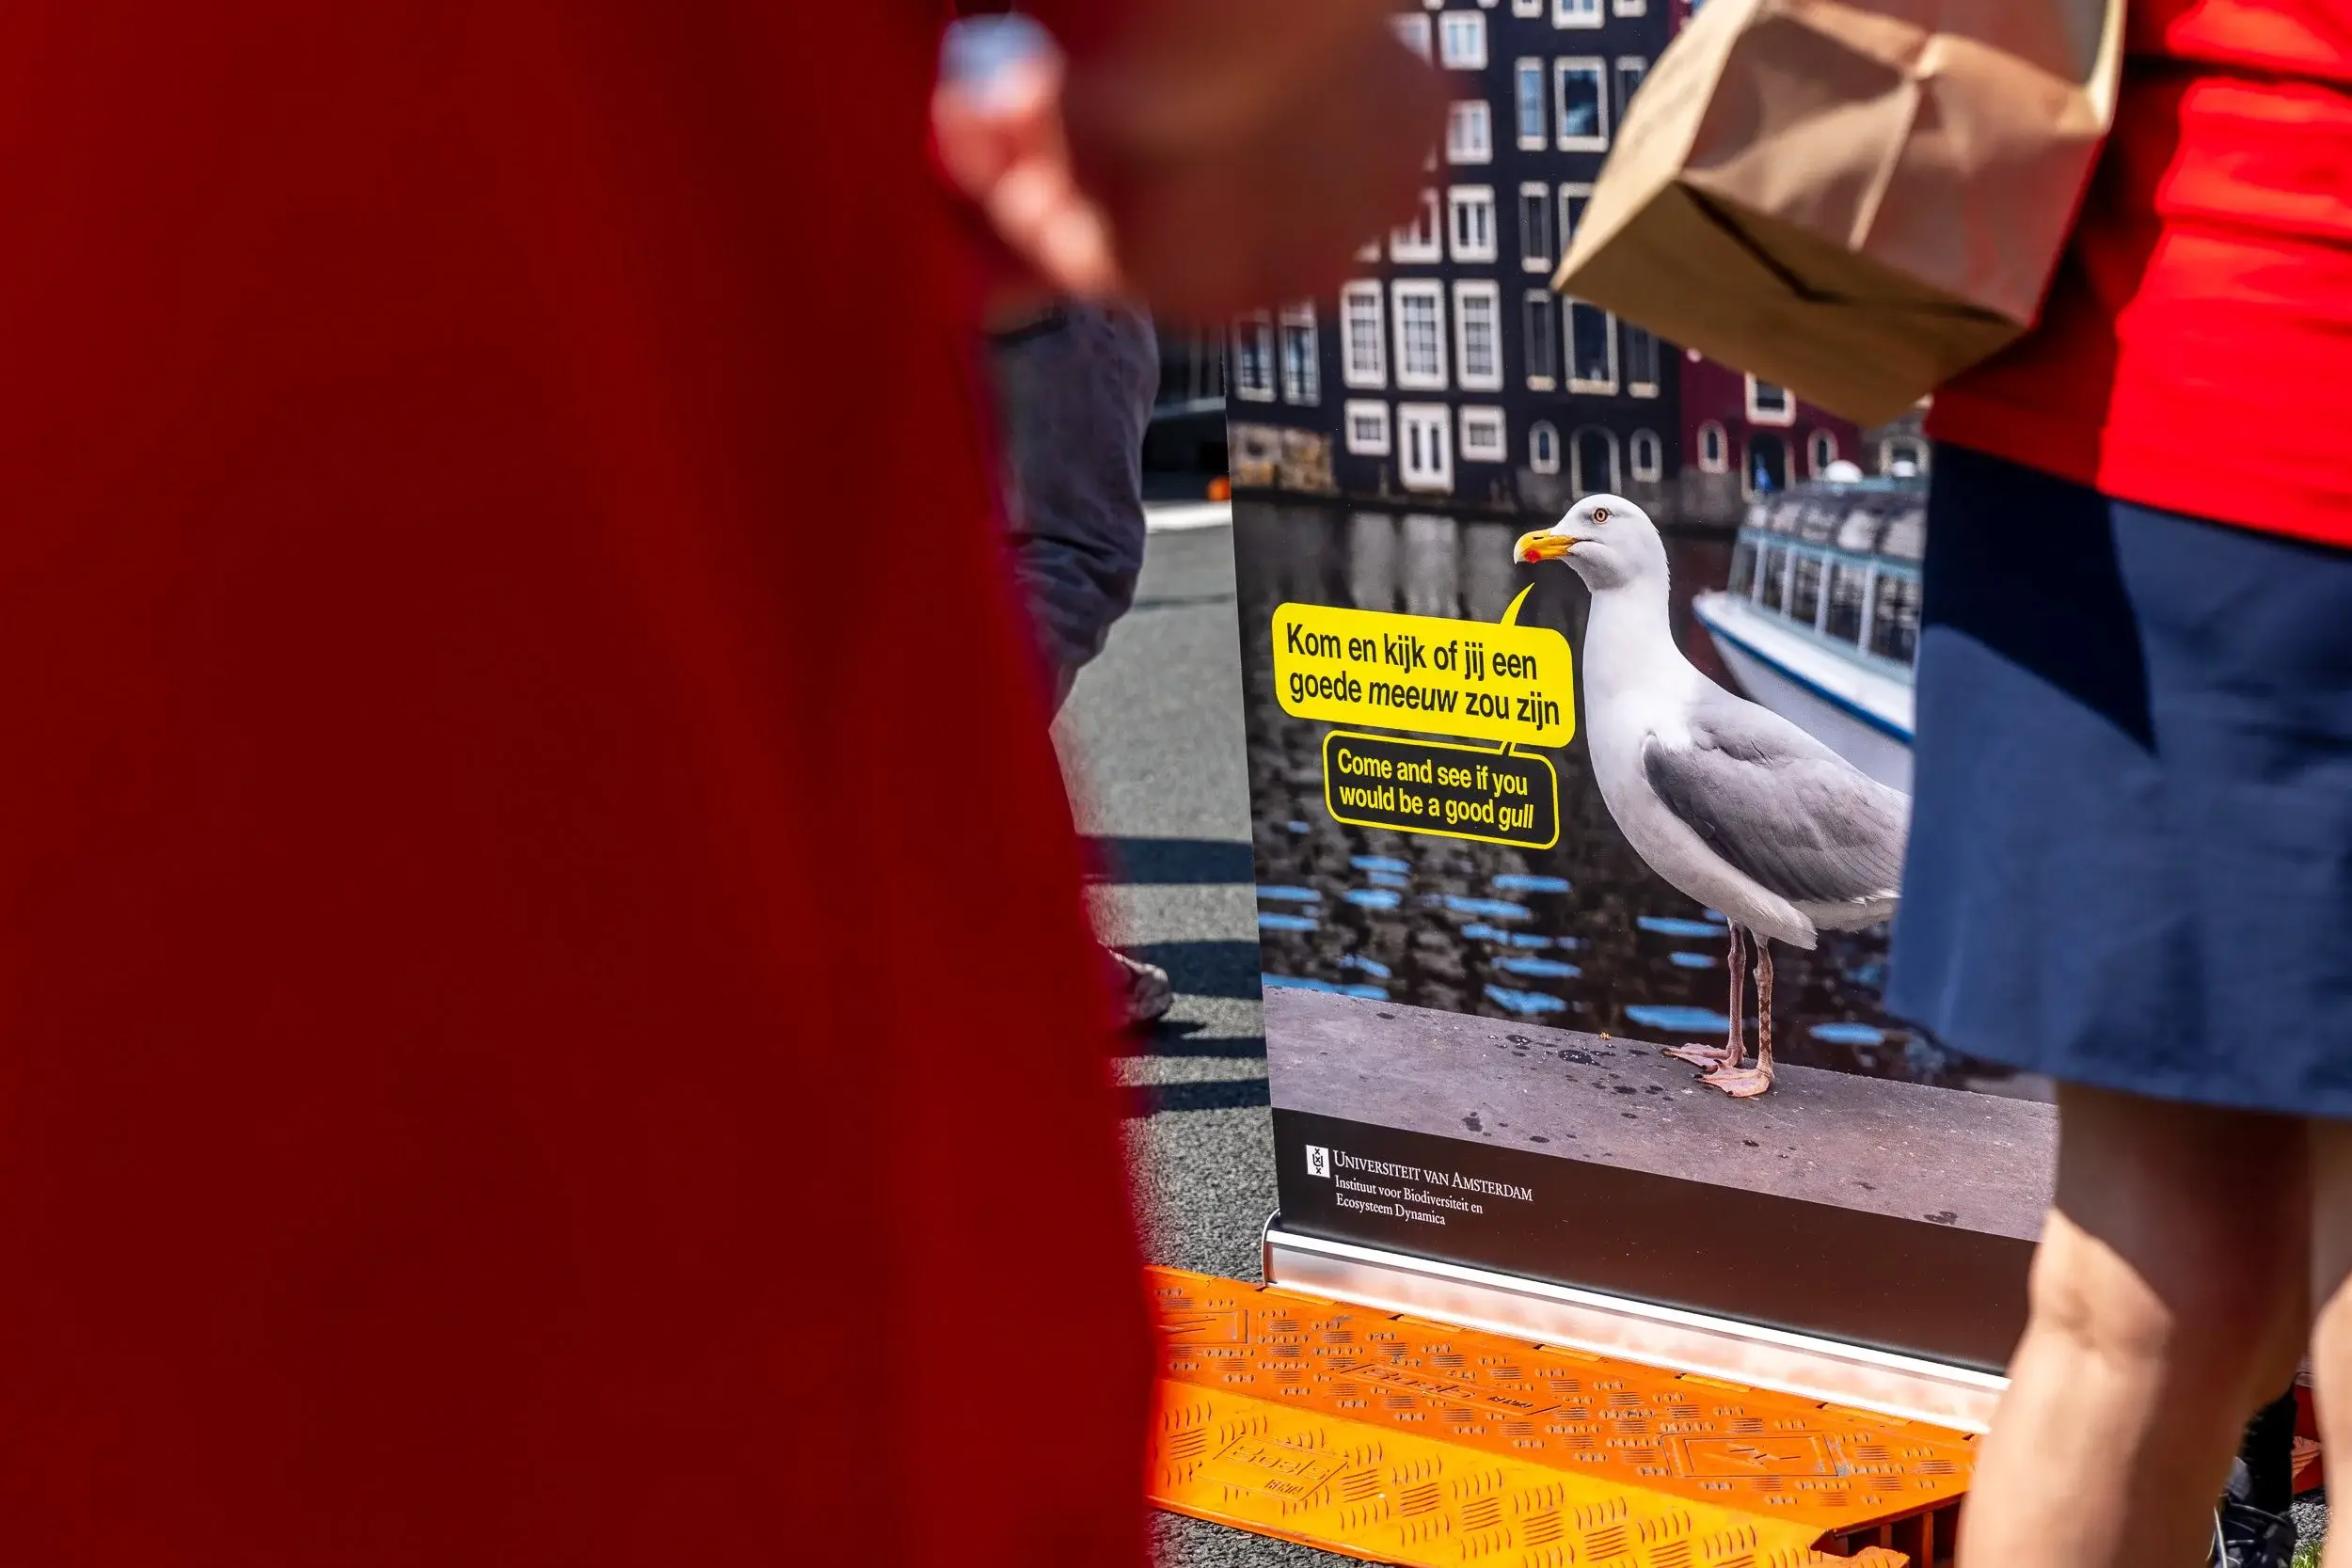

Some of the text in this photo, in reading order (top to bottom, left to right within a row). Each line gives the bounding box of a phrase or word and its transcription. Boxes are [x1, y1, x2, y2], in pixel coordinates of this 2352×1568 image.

[1287, 623, 1537, 681] Kom en kijk of jij een
[1290, 671, 1560, 731] goede meeuw zou zijn
[1338, 749, 1528, 798] Come and see if you
[1339, 784, 1534, 831] would be a good gull
[1333, 1150, 1533, 1201] UNIVERSITEIT VAN AMSTERDAM
[1336, 1175, 1483, 1213] Instituut voor Biodiversiteit en
[1336, 1193, 1445, 1225] Ecosysteem Dynamica
